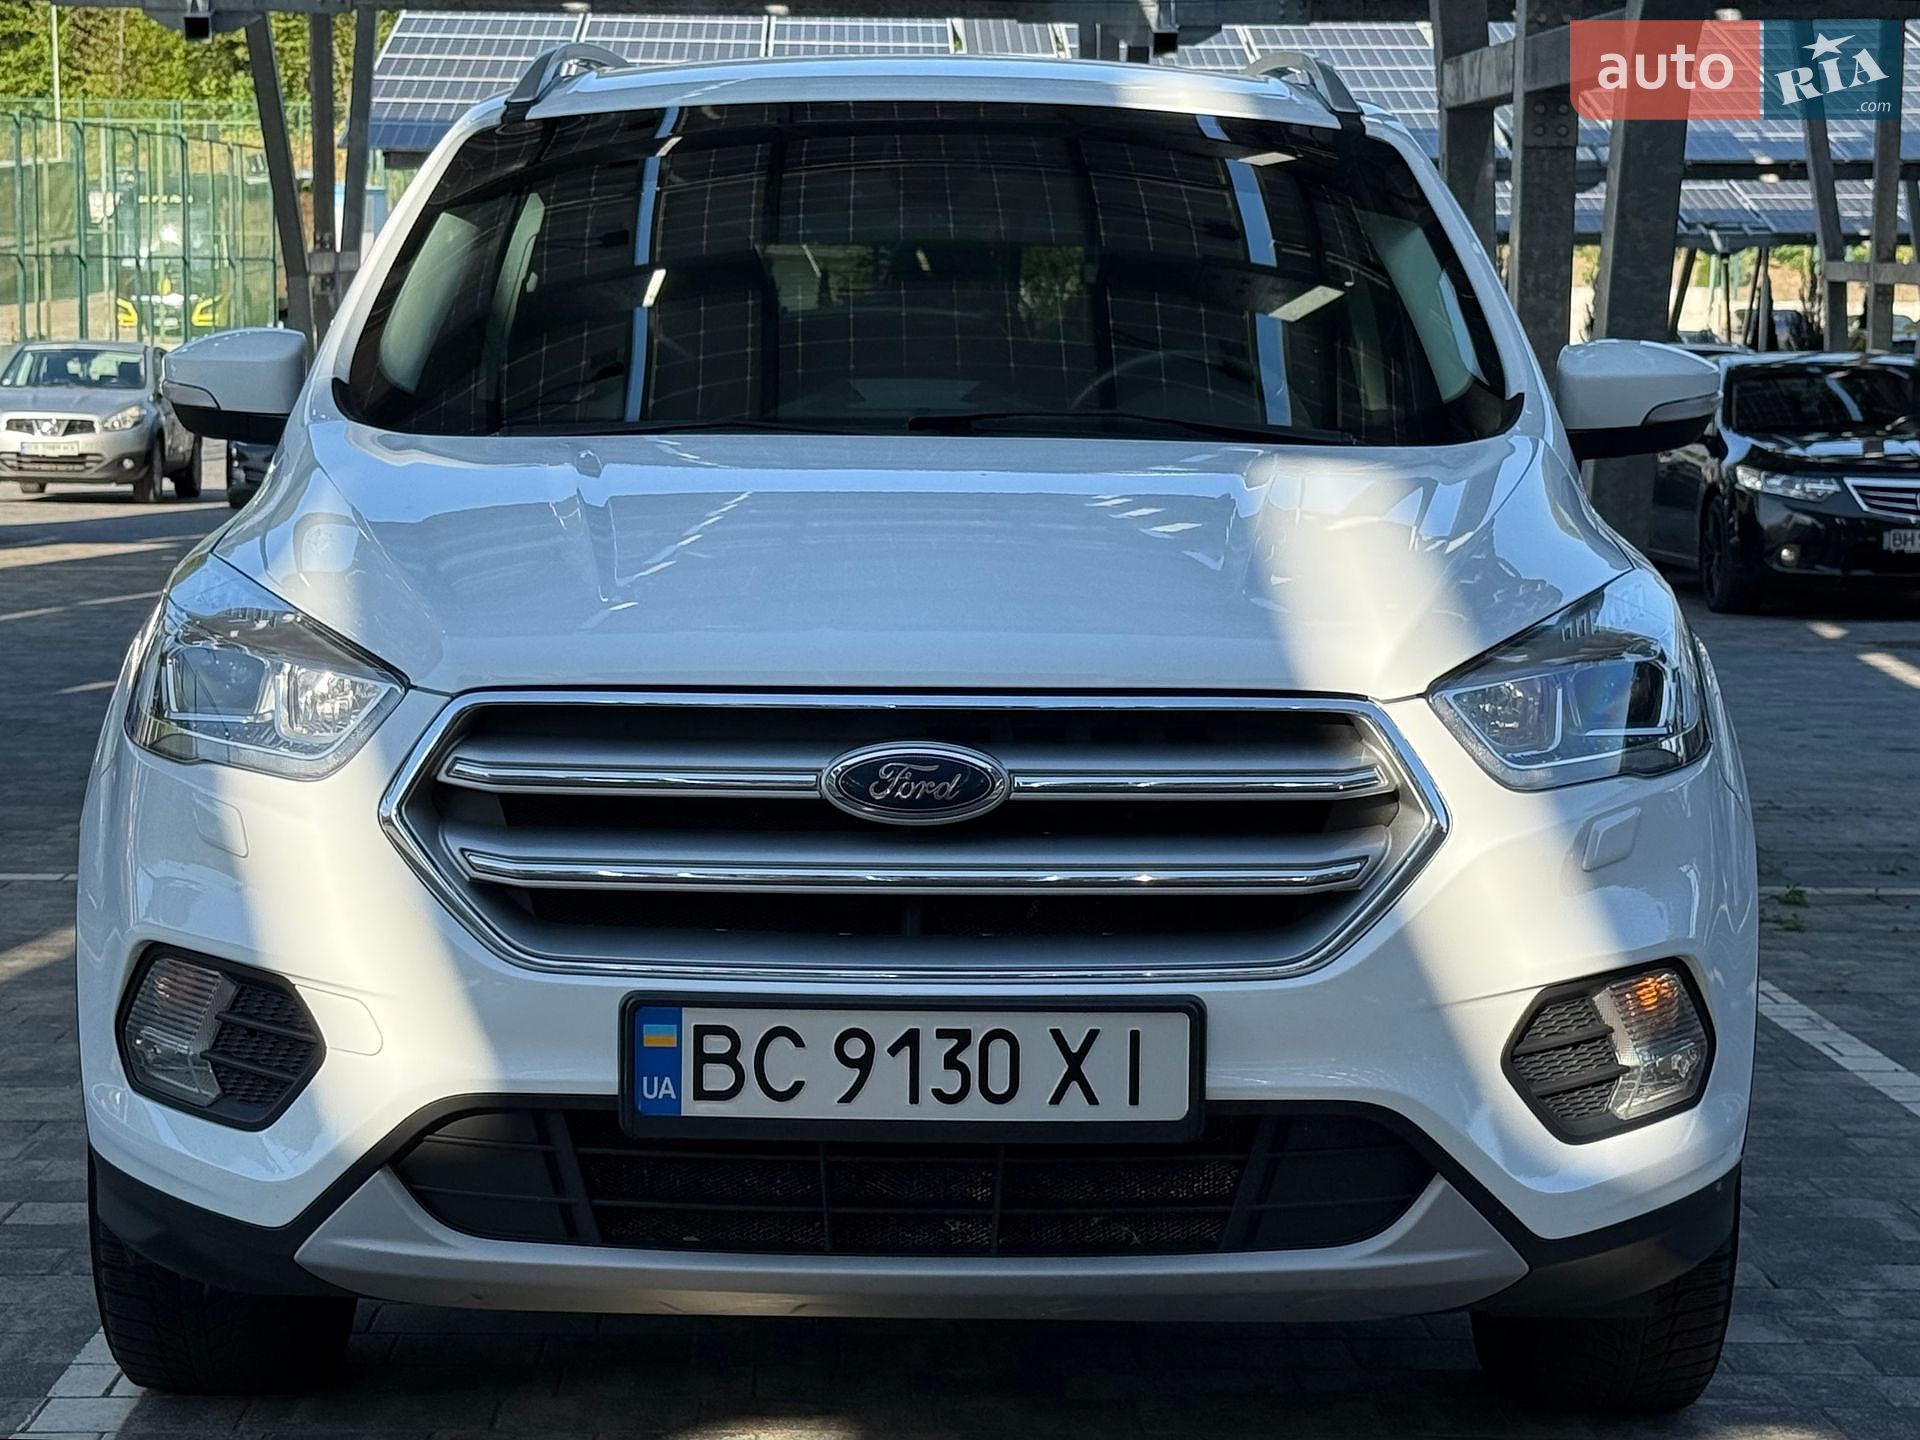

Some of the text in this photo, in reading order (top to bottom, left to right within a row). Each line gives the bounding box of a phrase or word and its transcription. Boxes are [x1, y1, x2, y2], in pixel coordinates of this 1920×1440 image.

[869, 762, 962, 800] Ford
[692, 1024, 806, 1102] BC
[833, 1027, 1021, 1104] 9130
[642, 1076, 677, 1100] UA
